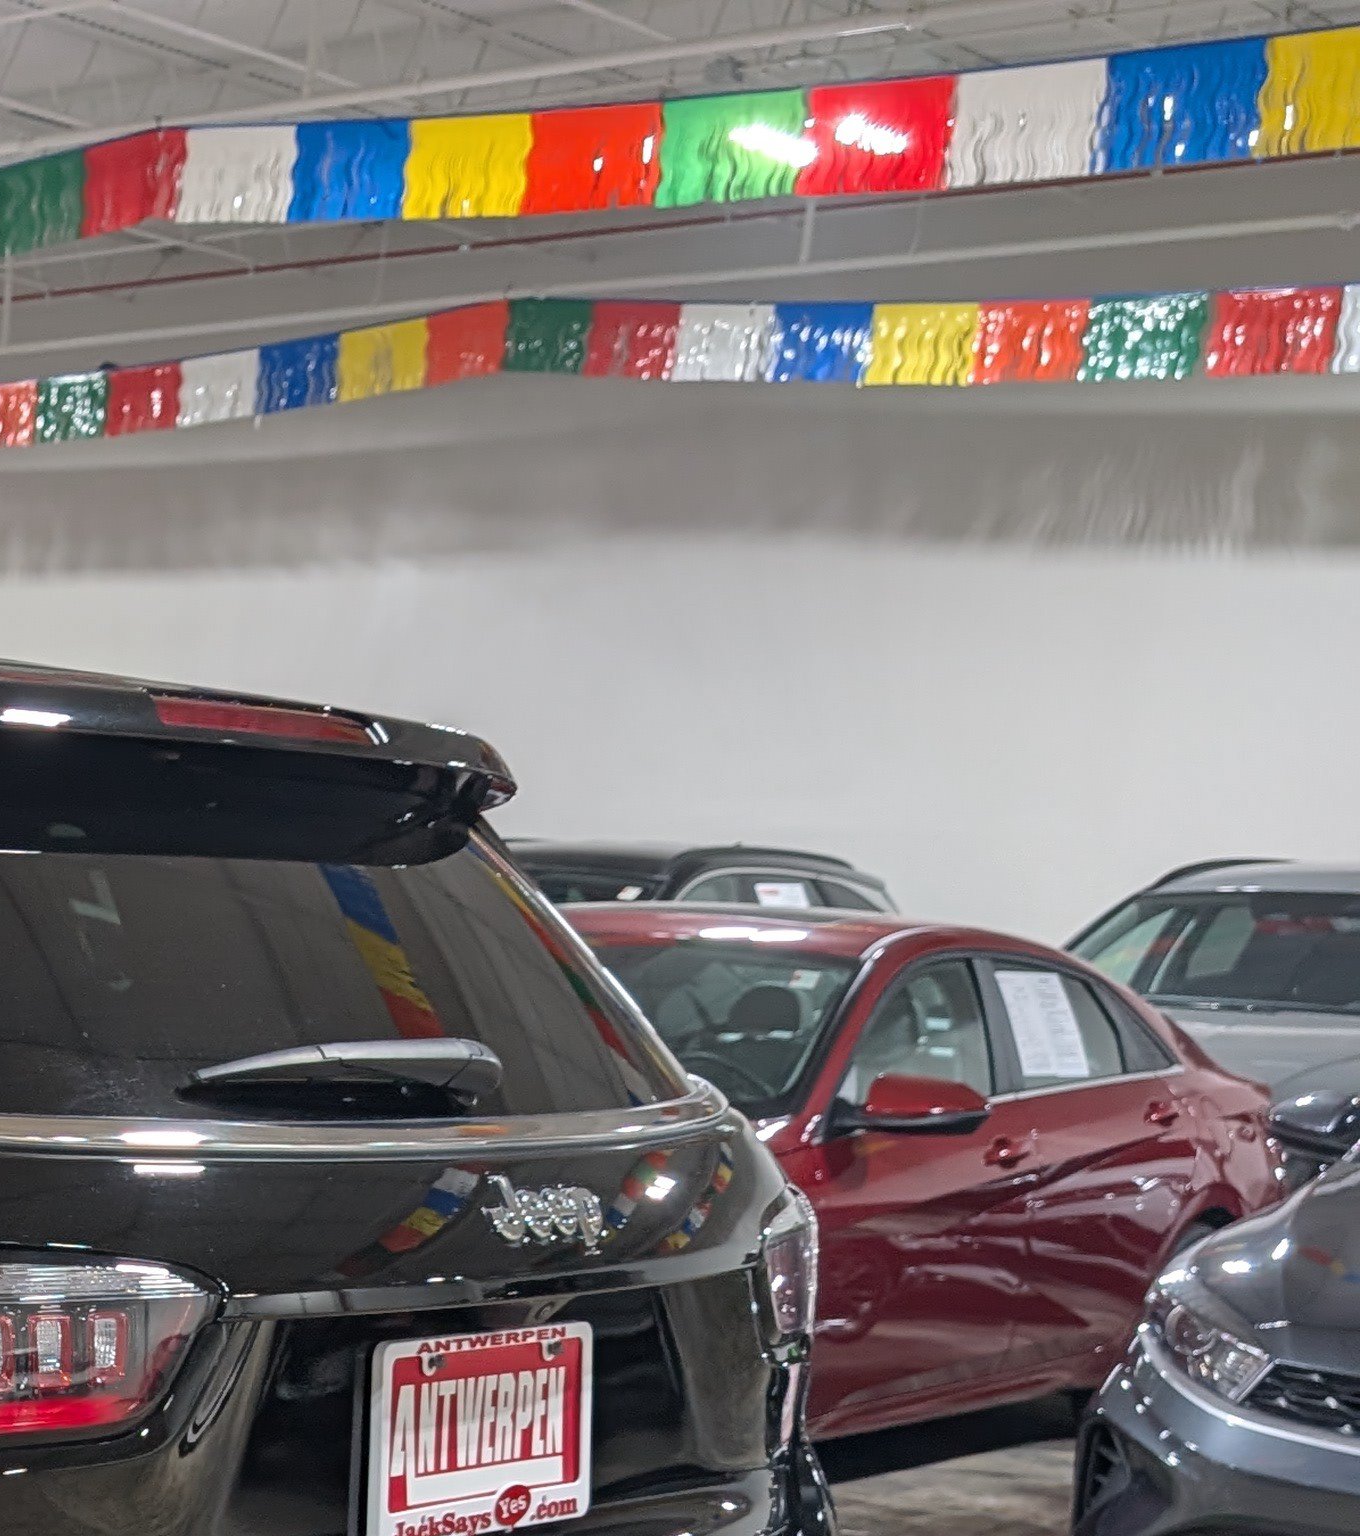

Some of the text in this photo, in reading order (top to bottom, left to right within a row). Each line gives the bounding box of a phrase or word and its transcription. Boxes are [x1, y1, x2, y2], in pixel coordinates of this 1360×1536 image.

[480, 1172, 604, 1247] Jeep
[416, 1326, 567, 1354] ANTWERPEN
[389, 1366, 566, 1477] ANTWERPEN
